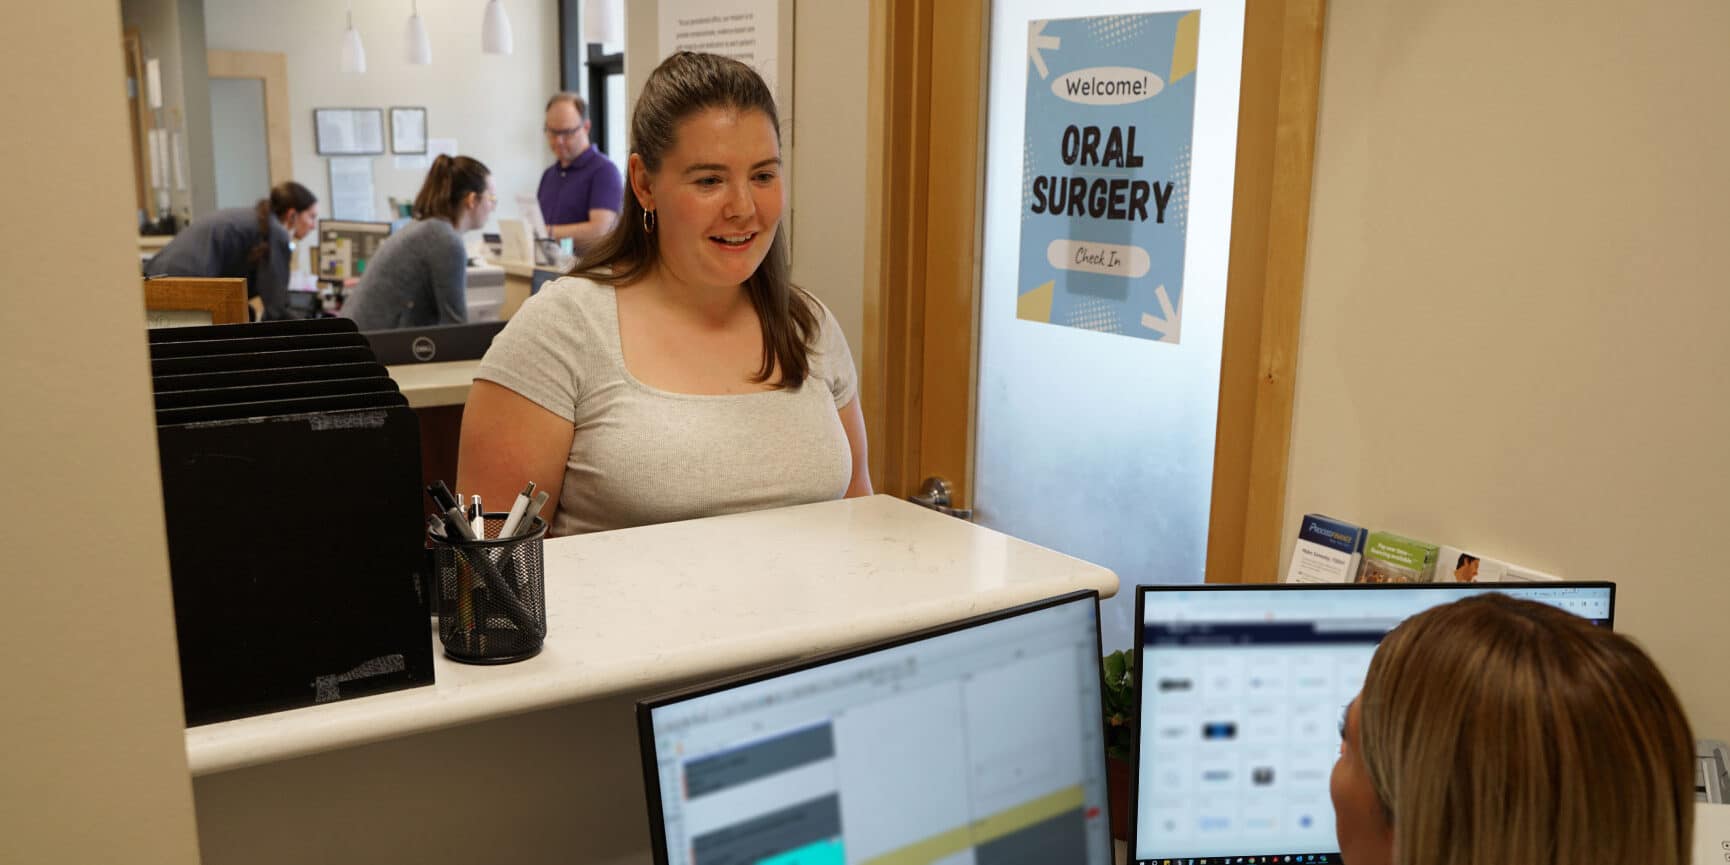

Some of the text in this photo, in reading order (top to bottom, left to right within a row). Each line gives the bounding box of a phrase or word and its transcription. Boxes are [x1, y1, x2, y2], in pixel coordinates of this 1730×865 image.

[1066, 76, 1147, 96] Welcome!
[1061, 124, 1144, 168] ORAL
[1031, 175, 1175, 224] SURGERY
[1075, 246, 1121, 267] Check In
